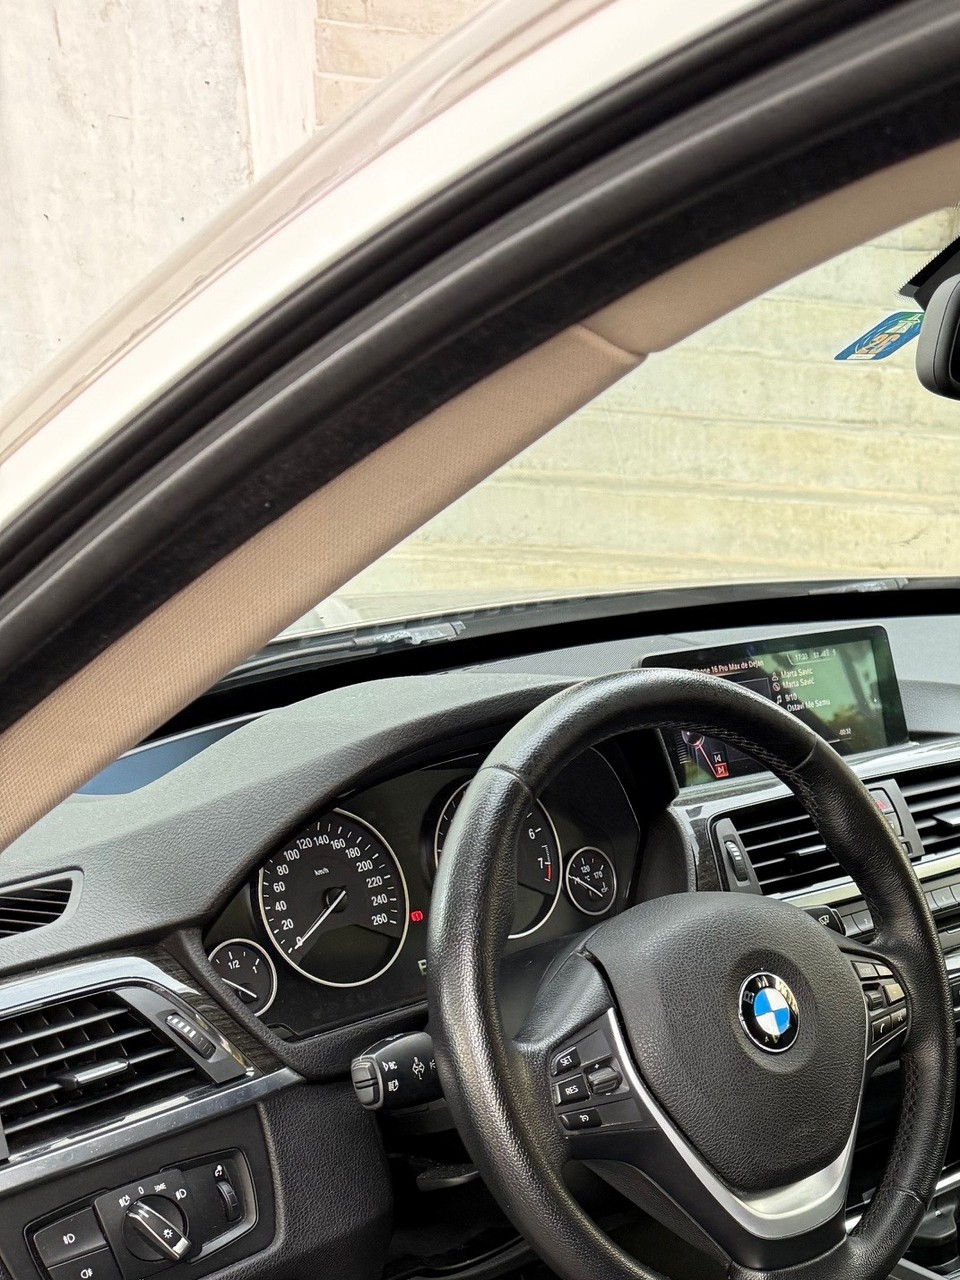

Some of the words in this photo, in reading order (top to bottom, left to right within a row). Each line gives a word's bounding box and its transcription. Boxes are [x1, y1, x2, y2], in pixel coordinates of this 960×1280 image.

[719, 664, 728, 672] Pro
[728, 662, 740, 671] Max
[741, 661, 748, 669] de
[781, 669, 798, 679] Marta
[782, 680, 800, 690] Marta
[313, 834, 330, 846] 140
[528, 828, 536, 840] 6
[296, 837, 313, 850] 120
[330, 838, 346, 850] 160
[283, 848, 300, 861] 100
[345, 846, 361, 859] 180
[355, 859, 373, 873] 200
[537, 857, 543, 869] 7
[276, 864, 289, 876] 80
[313, 867, 330, 876] km/h
[580, 865, 591, 874] 120
[593, 870, 604, 879] 170
[273, 881, 286, 893] 60
[365, 875, 383, 888] 220
[371, 893, 388, 906] 240
[275, 900, 287, 912] 40
[281, 918, 294, 931] 20
[371, 913, 388, 926] 260
[228, 960, 240, 970] 1/2
[559, 1055, 573, 1067] SET
[564, 1085, 579, 1096] RES
